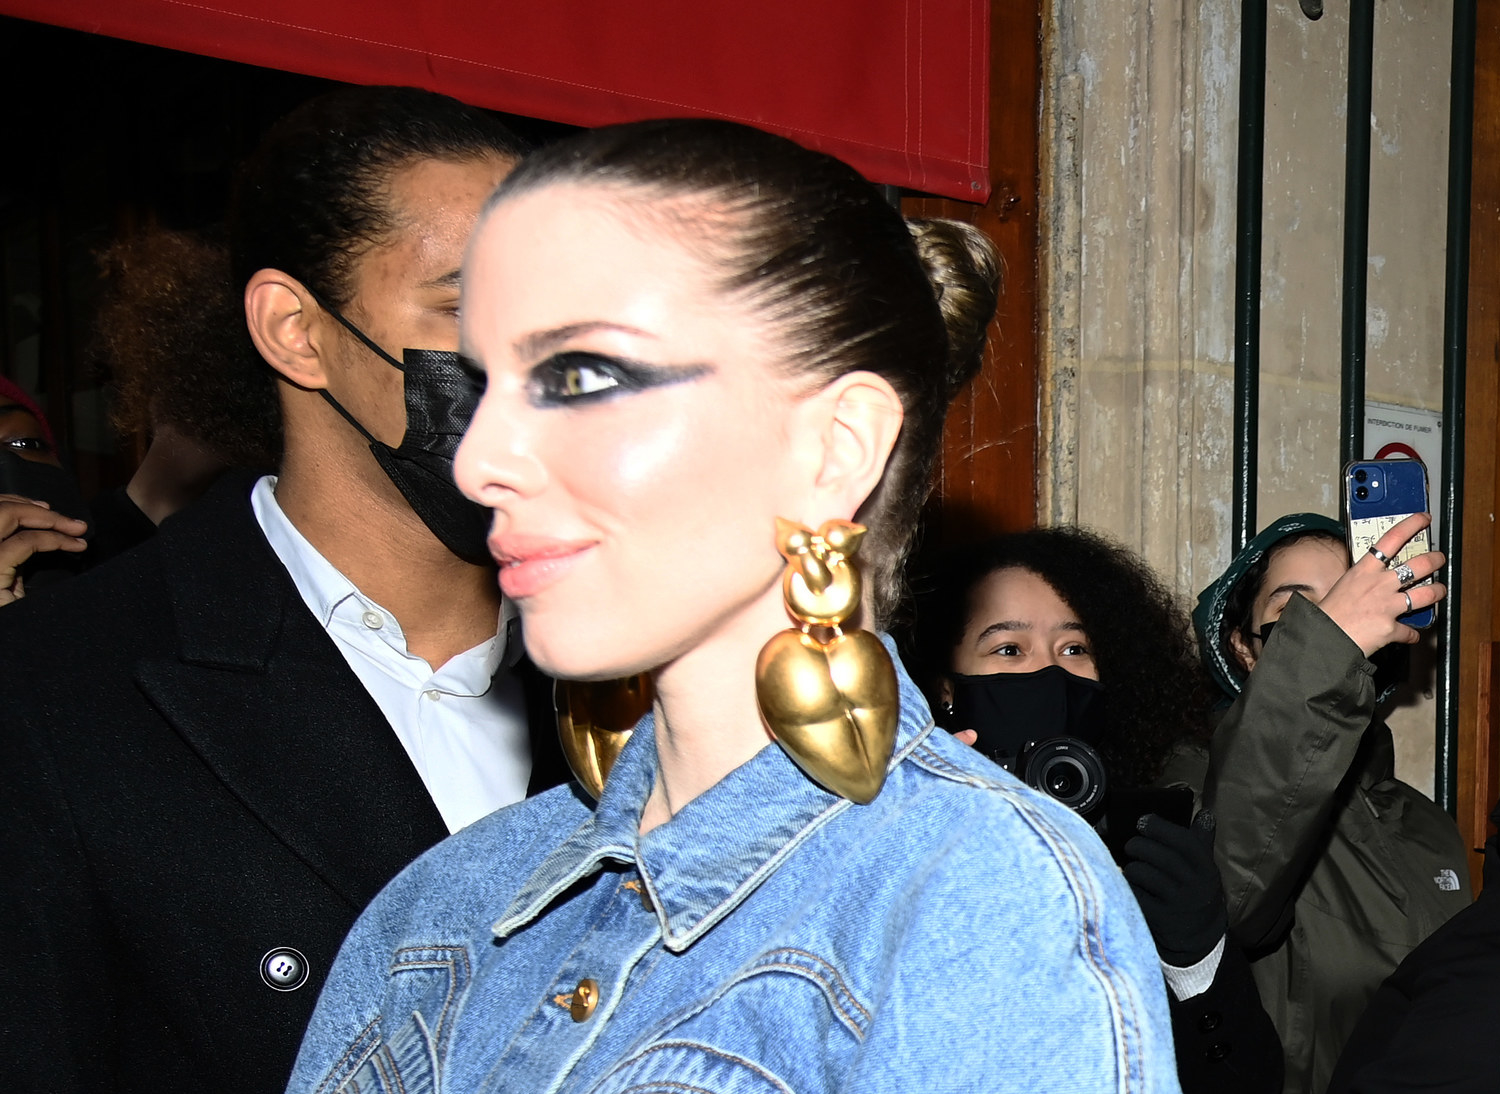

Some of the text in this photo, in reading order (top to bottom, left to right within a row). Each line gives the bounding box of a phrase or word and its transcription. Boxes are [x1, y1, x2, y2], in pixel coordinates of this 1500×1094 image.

[1367, 418, 1432, 433] INTERDICTION DE FUMER
